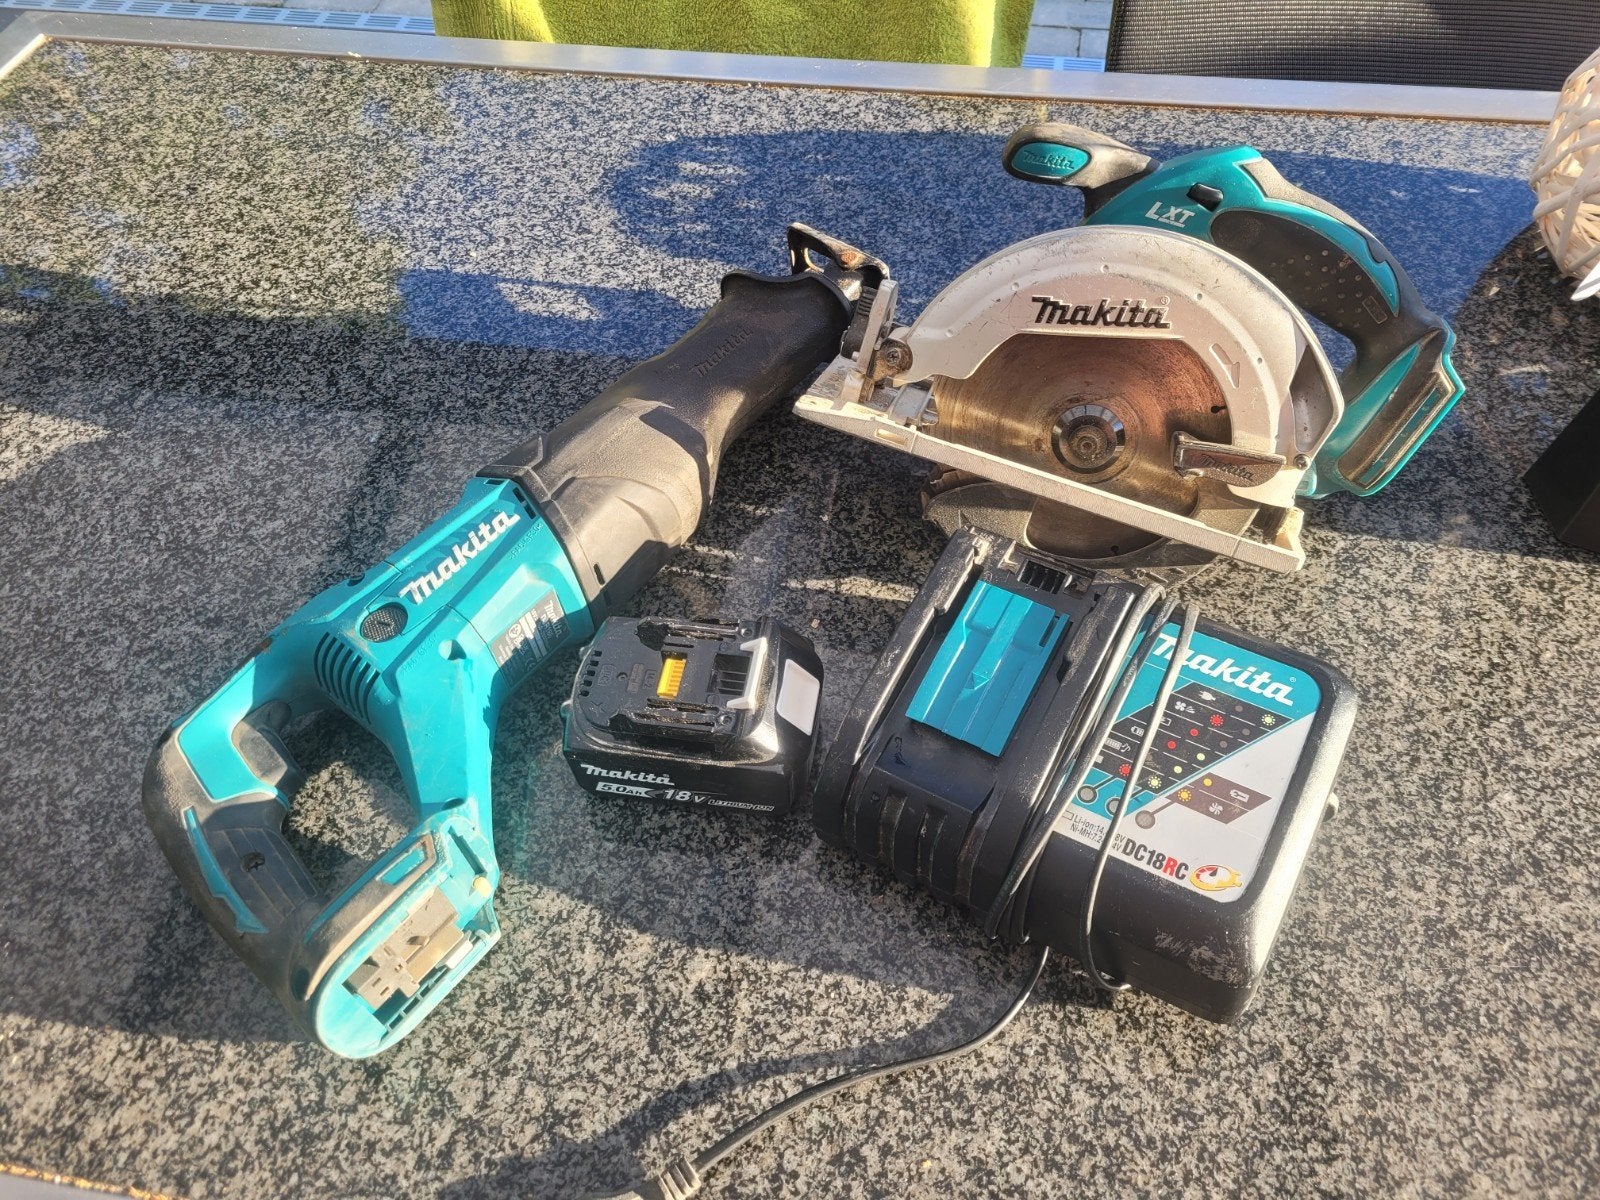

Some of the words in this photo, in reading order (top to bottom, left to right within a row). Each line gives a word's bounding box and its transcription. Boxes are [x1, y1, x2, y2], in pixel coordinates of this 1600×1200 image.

[1145, 201, 1195, 224] LXT
[600, 783, 643, 797] 5.0Ah
[1121, 838, 1189, 880] DC18RC
